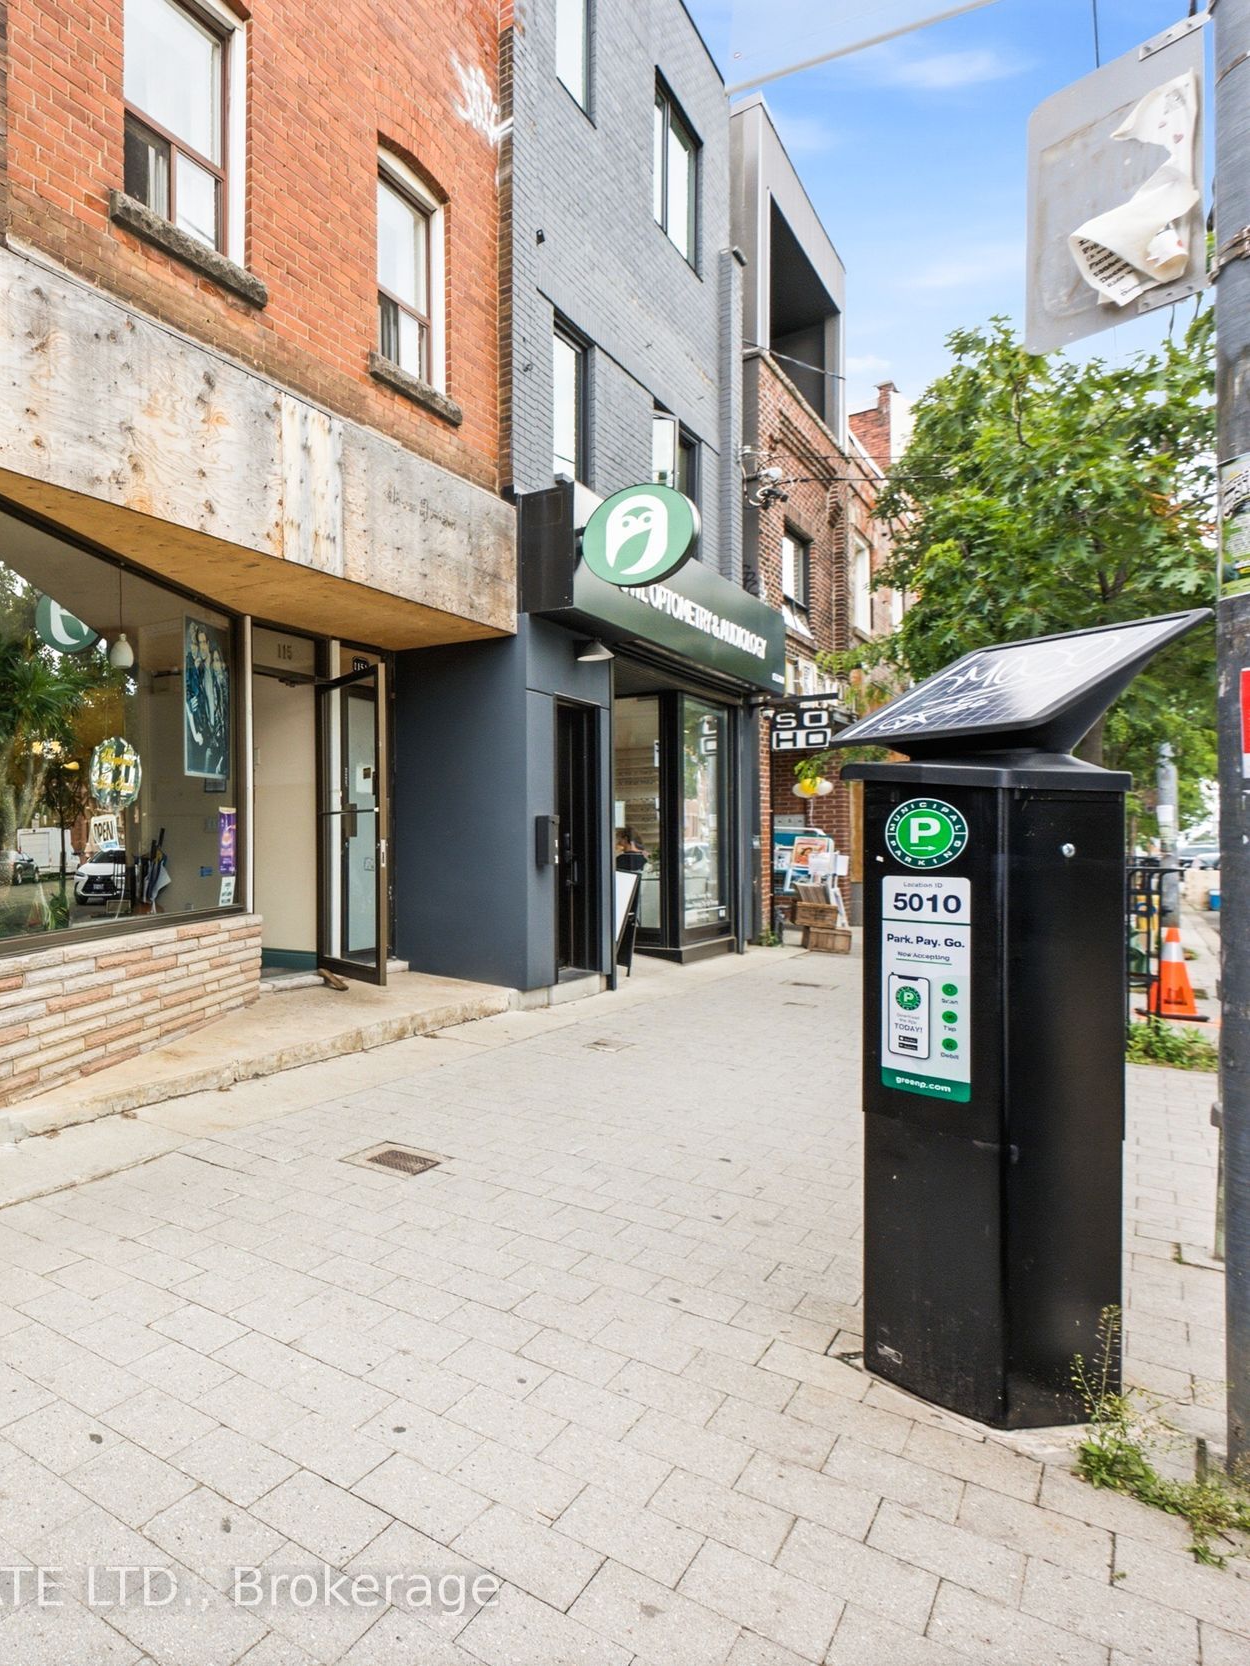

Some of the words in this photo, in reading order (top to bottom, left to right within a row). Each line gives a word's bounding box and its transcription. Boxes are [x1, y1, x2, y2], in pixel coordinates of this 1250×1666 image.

[649, 584, 713, 634] OPTOMETRY
[277, 644, 292, 659] 115
[775, 711, 829, 729] SO
[775, 730, 828, 748] HO
[890, 802, 963, 832] MUNICIPAL
[910, 817, 941, 844] P
[890, 840, 963, 866] PARKING
[903, 881, 932, 889] Location
[893, 892, 962, 914] 5010
[886, 933, 914, 945] Park.
[916, 936, 941, 948] Pay.
[944, 938, 965, 949] Go.
[894, 1022, 924, 1034] TODAY!
[895, 1076, 952, 1093] greenp.com
